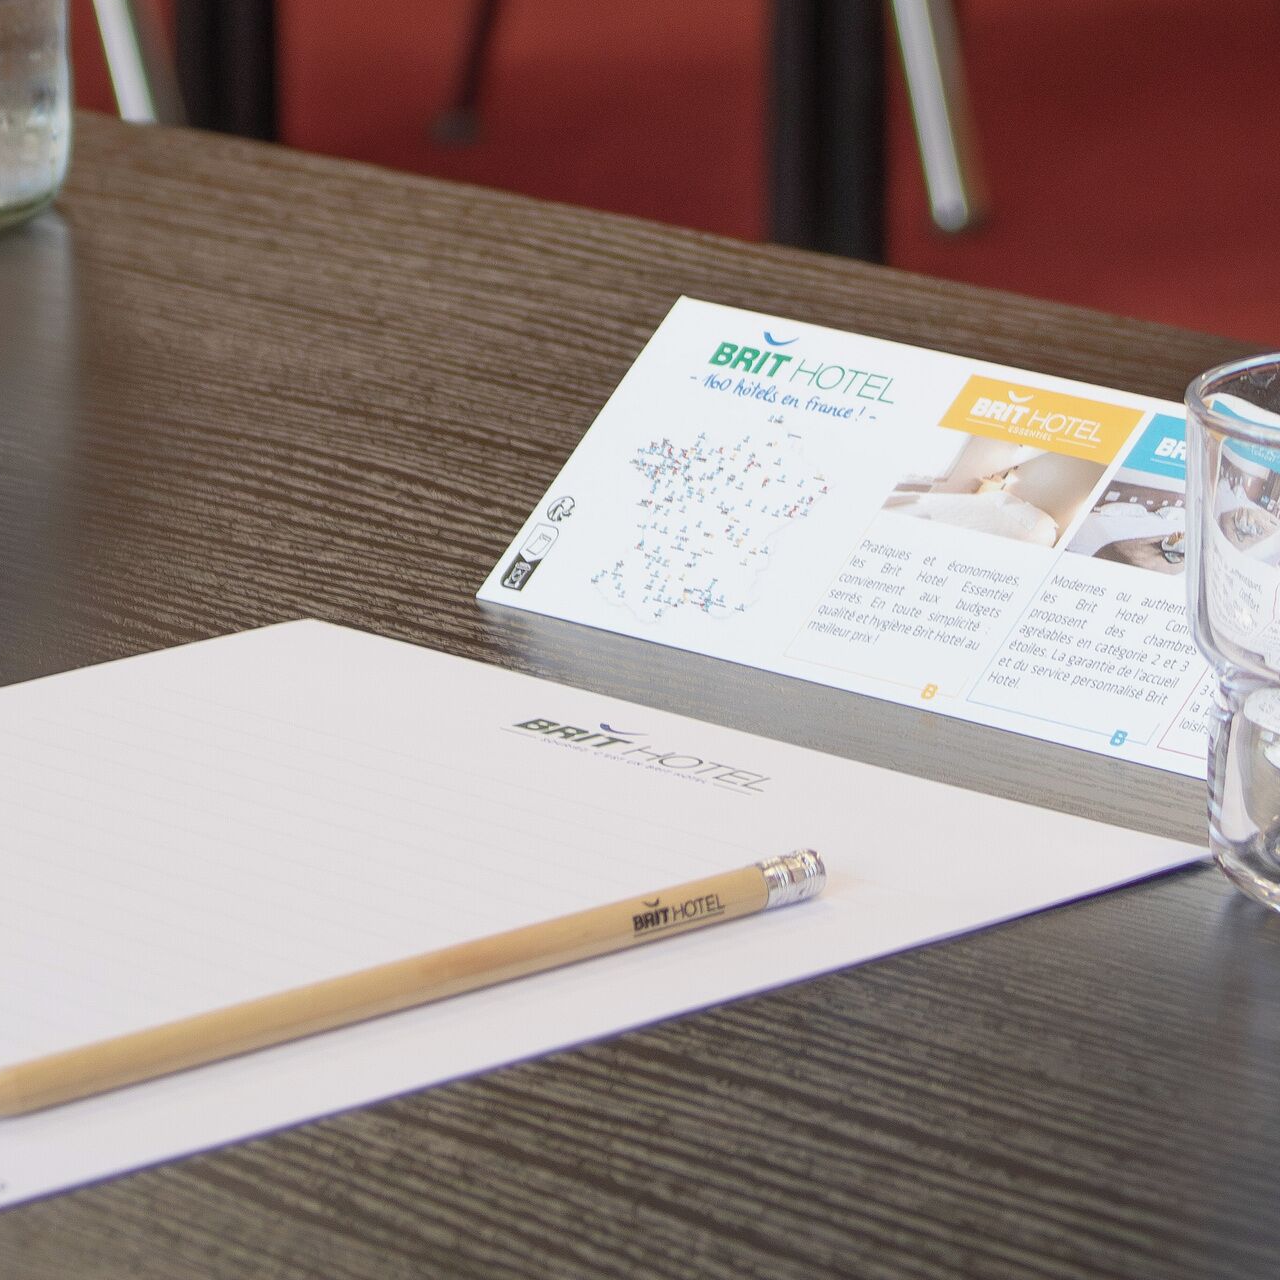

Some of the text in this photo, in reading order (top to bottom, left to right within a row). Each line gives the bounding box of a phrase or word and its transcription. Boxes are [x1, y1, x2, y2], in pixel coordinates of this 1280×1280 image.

[703, 373, 731, 392] 160
[781, 394, 799, 409] en
[708, 342, 894, 404] BRIT HOTEL
[970, 397, 1102, 443] BRIT HOTEL
[1007, 425, 1052, 442] ESSENTIEL
[1154, 436, 1186, 460] BR
[859, 539, 912, 562] Pratiques
[923, 555, 937, 568] et
[838, 572, 1002, 620] conviennent aux budgets
[849, 555, 1014, 603] les Brit Hotel Essentiel
[1051, 574, 1187, 616] Modernes ou authent
[817, 604, 980, 652] qualité et hygiène Brit Hotel au
[870, 597, 887, 610] En
[891, 602, 923, 619] toute
[928, 611, 981, 634] simplicité
[1040, 590, 1058, 605] les
[1075, 598, 1099, 614] Brit
[1115, 607, 1148, 625] Hotel
[807, 620, 853, 641] meilleur
[849, 631, 873, 645] prix
[1019, 622, 1190, 672] agréables en catégorie 2 et 3
[1028, 607, 1198, 656] proposent des chambres
[998, 656, 1169, 706] et du service personnalisé Brit
[1051, 649, 1066, 661] La
[1068, 653, 1116, 675] garantie
[1116, 664, 1132, 678] de
[1132, 668, 1180, 690] l'accueil
[512, 718, 771, 792] BRIT HOTEL
[632, 894, 725, 931] BRIT HOTEL
